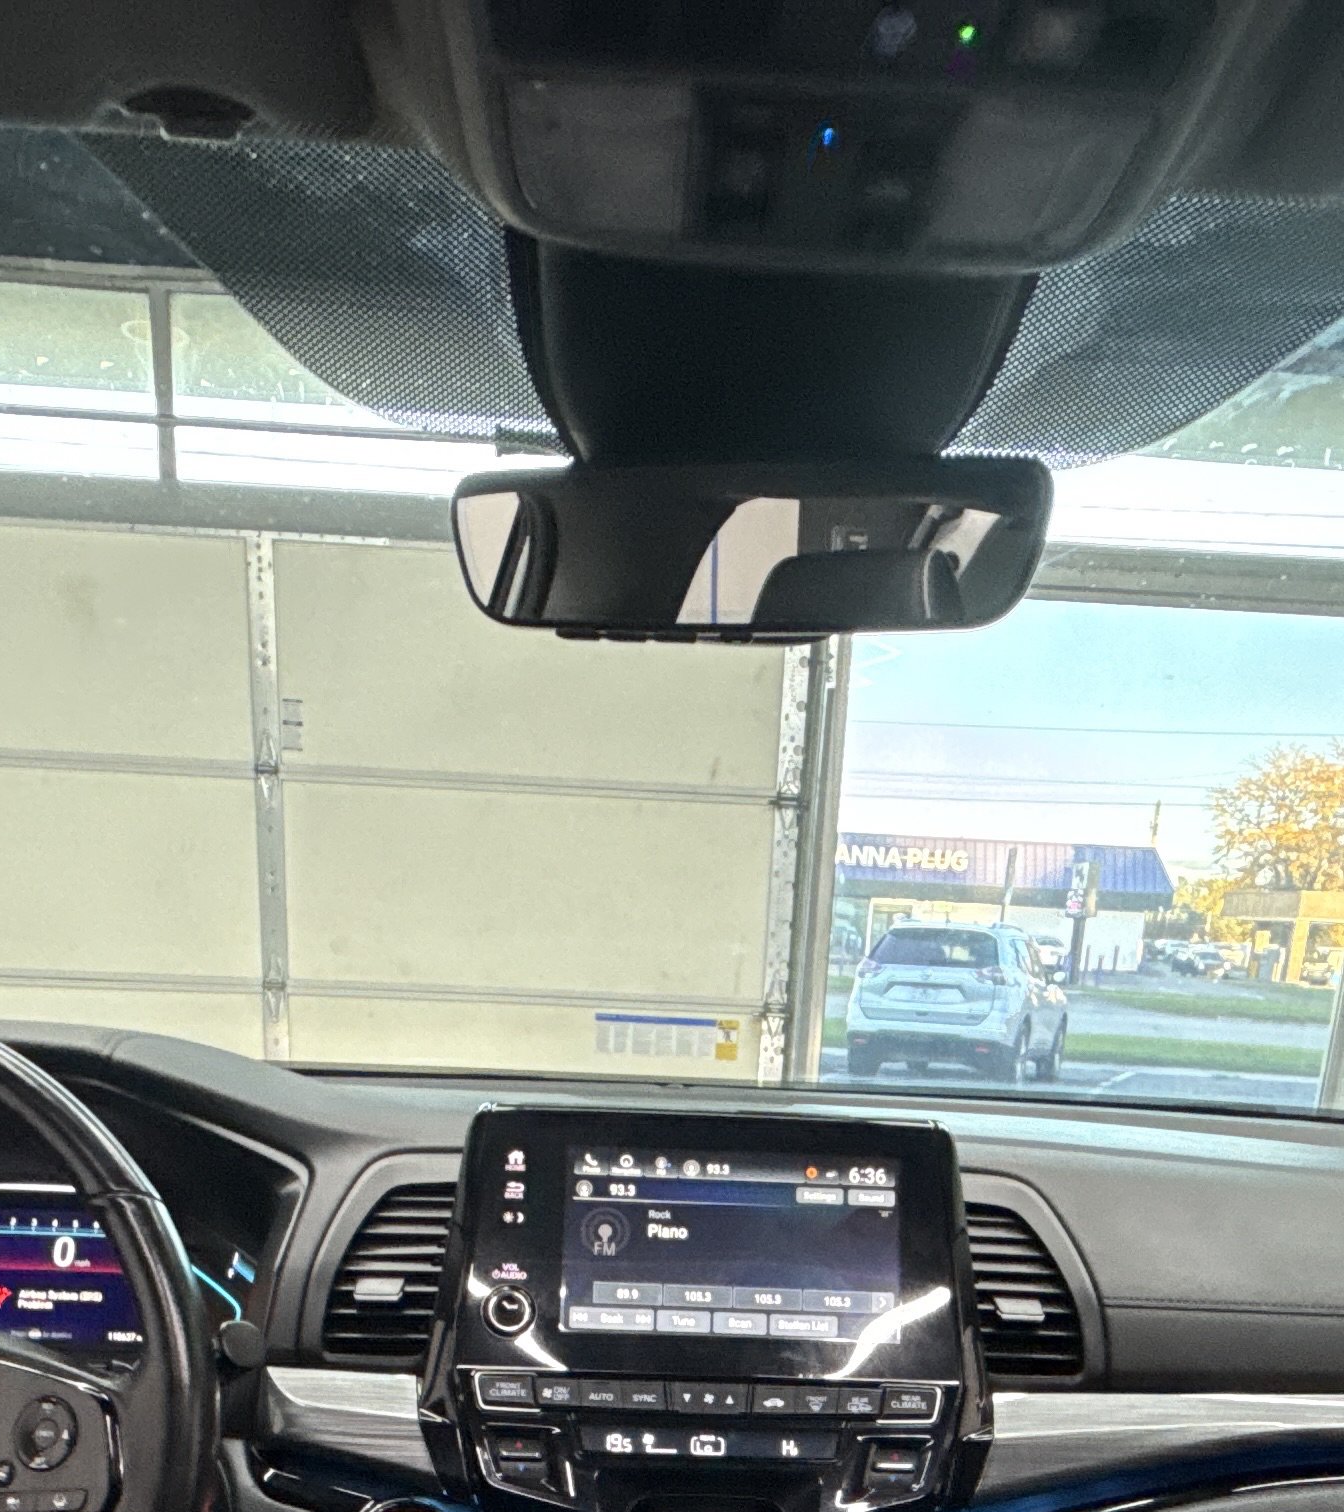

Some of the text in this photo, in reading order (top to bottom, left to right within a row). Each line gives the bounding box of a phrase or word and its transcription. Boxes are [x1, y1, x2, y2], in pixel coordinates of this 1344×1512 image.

[706, 1163, 731, 1176] 93.3
[847, 1166, 888, 1186] 6:36
[609, 1183, 637, 1198] 93.3
[648, 1209, 672, 1220] Rock
[647, 1223, 689, 1240] Piano
[53, 1236, 76, 1268] 0
[592, 1241, 616, 1257] FM
[502, 1262, 520, 1272] VOL
[500, 1270, 528, 1281] AUDIO
[672, 1315, 696, 1327] Tune
[489, 1389, 527, 1397] CLIMATE
[589, 1392, 614, 1401] AUTO
[632, 1394, 657, 1403] SYNC
[890, 1401, 928, 1410] CLIMATE
